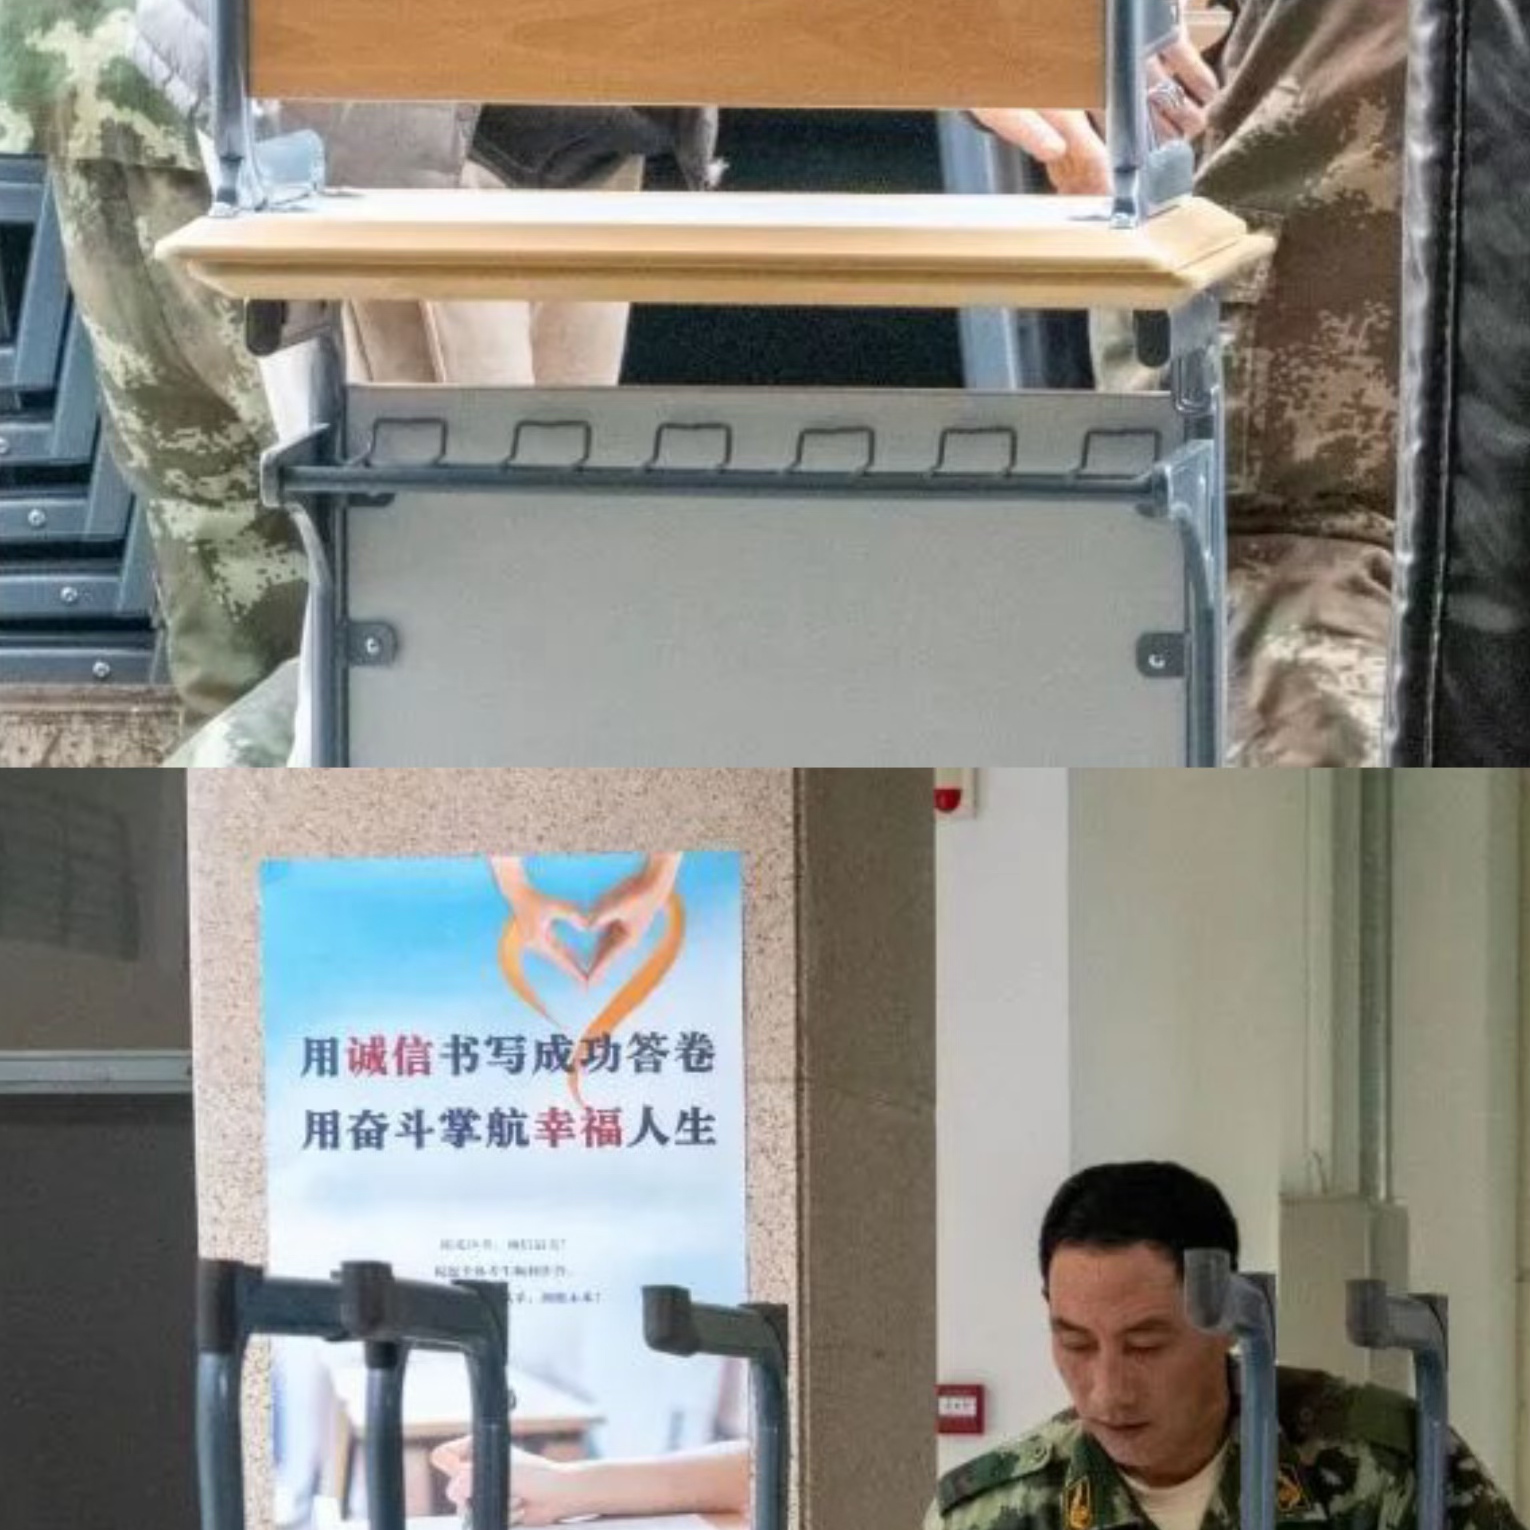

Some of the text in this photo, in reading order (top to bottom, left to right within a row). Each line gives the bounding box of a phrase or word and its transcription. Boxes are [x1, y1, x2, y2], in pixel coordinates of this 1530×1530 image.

[300, 1031, 717, 1079] 用诚信书写成功答卷
[301, 1106, 718, 1152] 用奋斗掌航幸福人生
